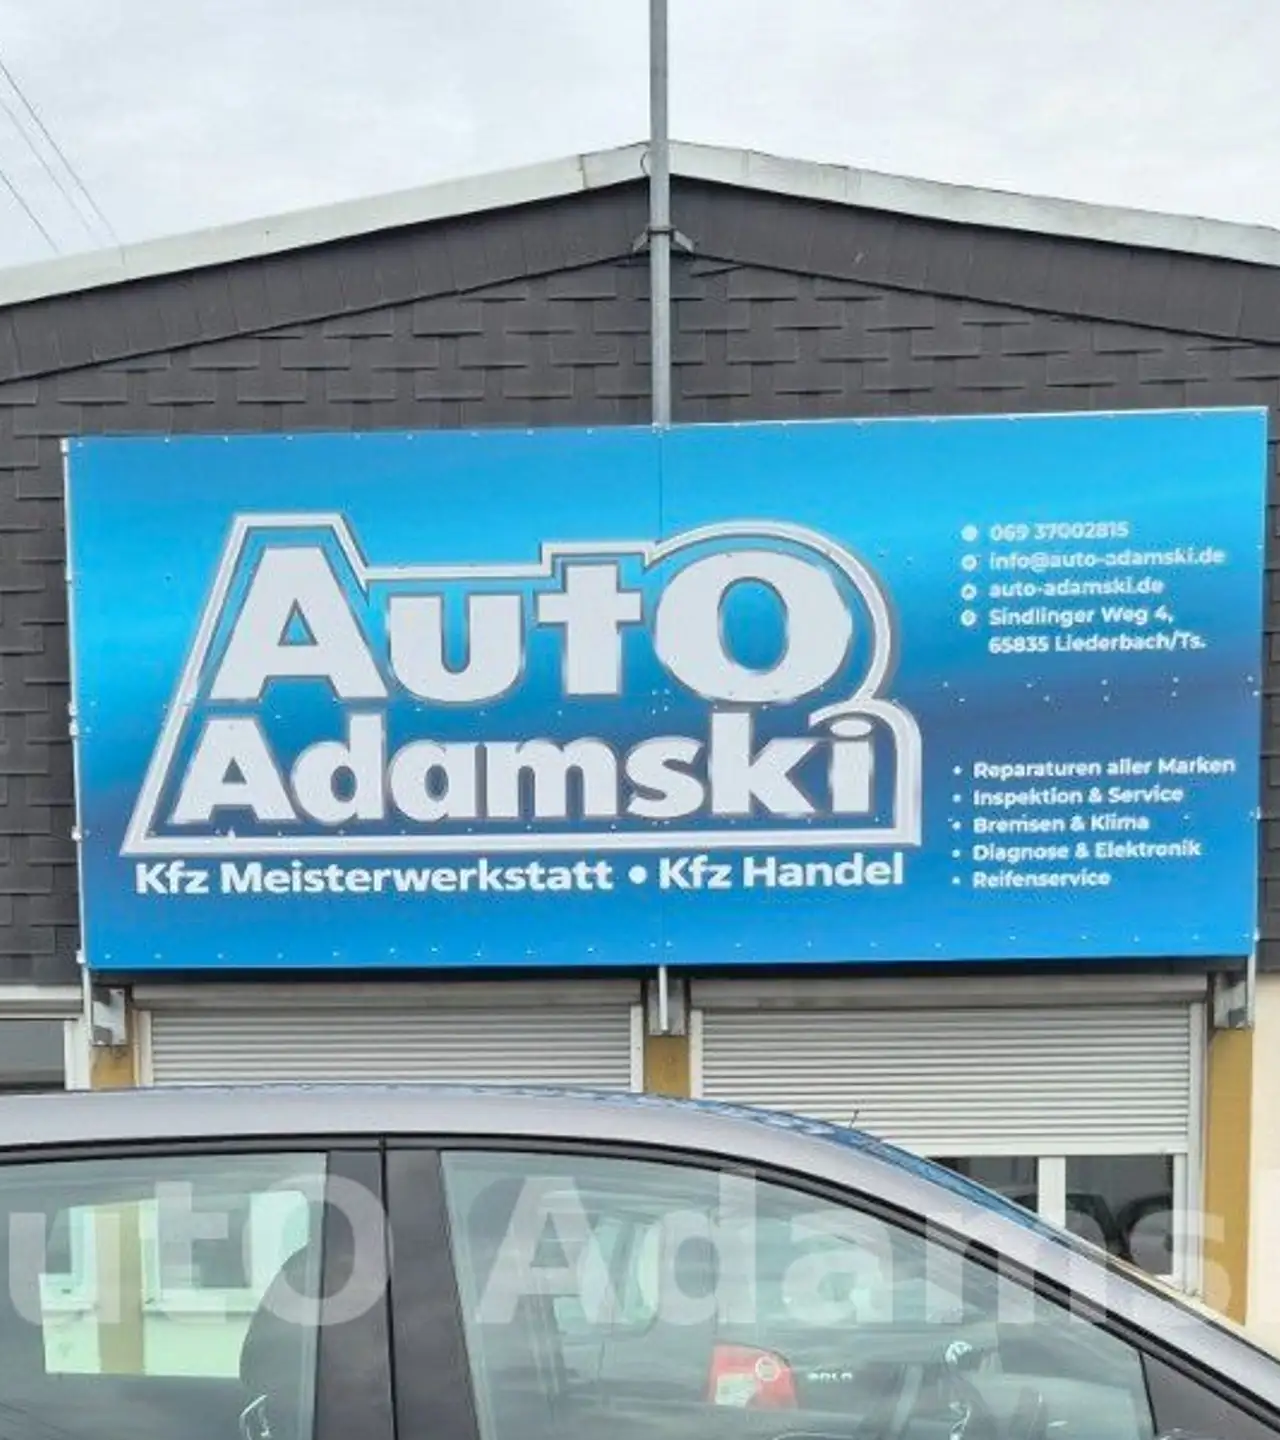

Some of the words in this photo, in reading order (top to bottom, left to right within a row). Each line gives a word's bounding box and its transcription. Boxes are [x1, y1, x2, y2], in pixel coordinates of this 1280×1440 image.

[989, 525, 1029, 541] 069
[1034, 521, 1130, 541] 37002815
[989, 547, 1226, 573] info@auto-adamski.de
[988, 575, 1164, 599] auto-adamski.de
[988, 605, 1095, 628] Sindlinger
[1101, 605, 1149, 626] Weg
[987, 634, 1049, 654] 65835
[1054, 630, 1206, 652] Liederbach/Ts.
[170, 713, 875, 824] Adamski
[972, 760, 1101, 780] Reparaturen
[1106, 757, 1152, 775] aller
[1158, 755, 1237, 775] Marken
[972, 787, 1083, 808] Inspektion
[1088, 786, 1102, 802] &
[1107, 784, 1184, 802] Service
[972, 817, 1065, 834] Bremsen
[1070, 814, 1085, 831] &
[1090, 811, 1150, 831] Klima
[972, 843, 1070, 864] Diagnose
[1074, 842, 1089, 859] &
[1095, 839, 1201, 858] Elektronik
[135, 863, 209, 895] Kfz
[221, 860, 613, 893] Meisterwerkstatt
[658, 858, 733, 890] Kfz
[744, 854, 903, 888] Handel
[972, 868, 1111, 888] Reifenservice
